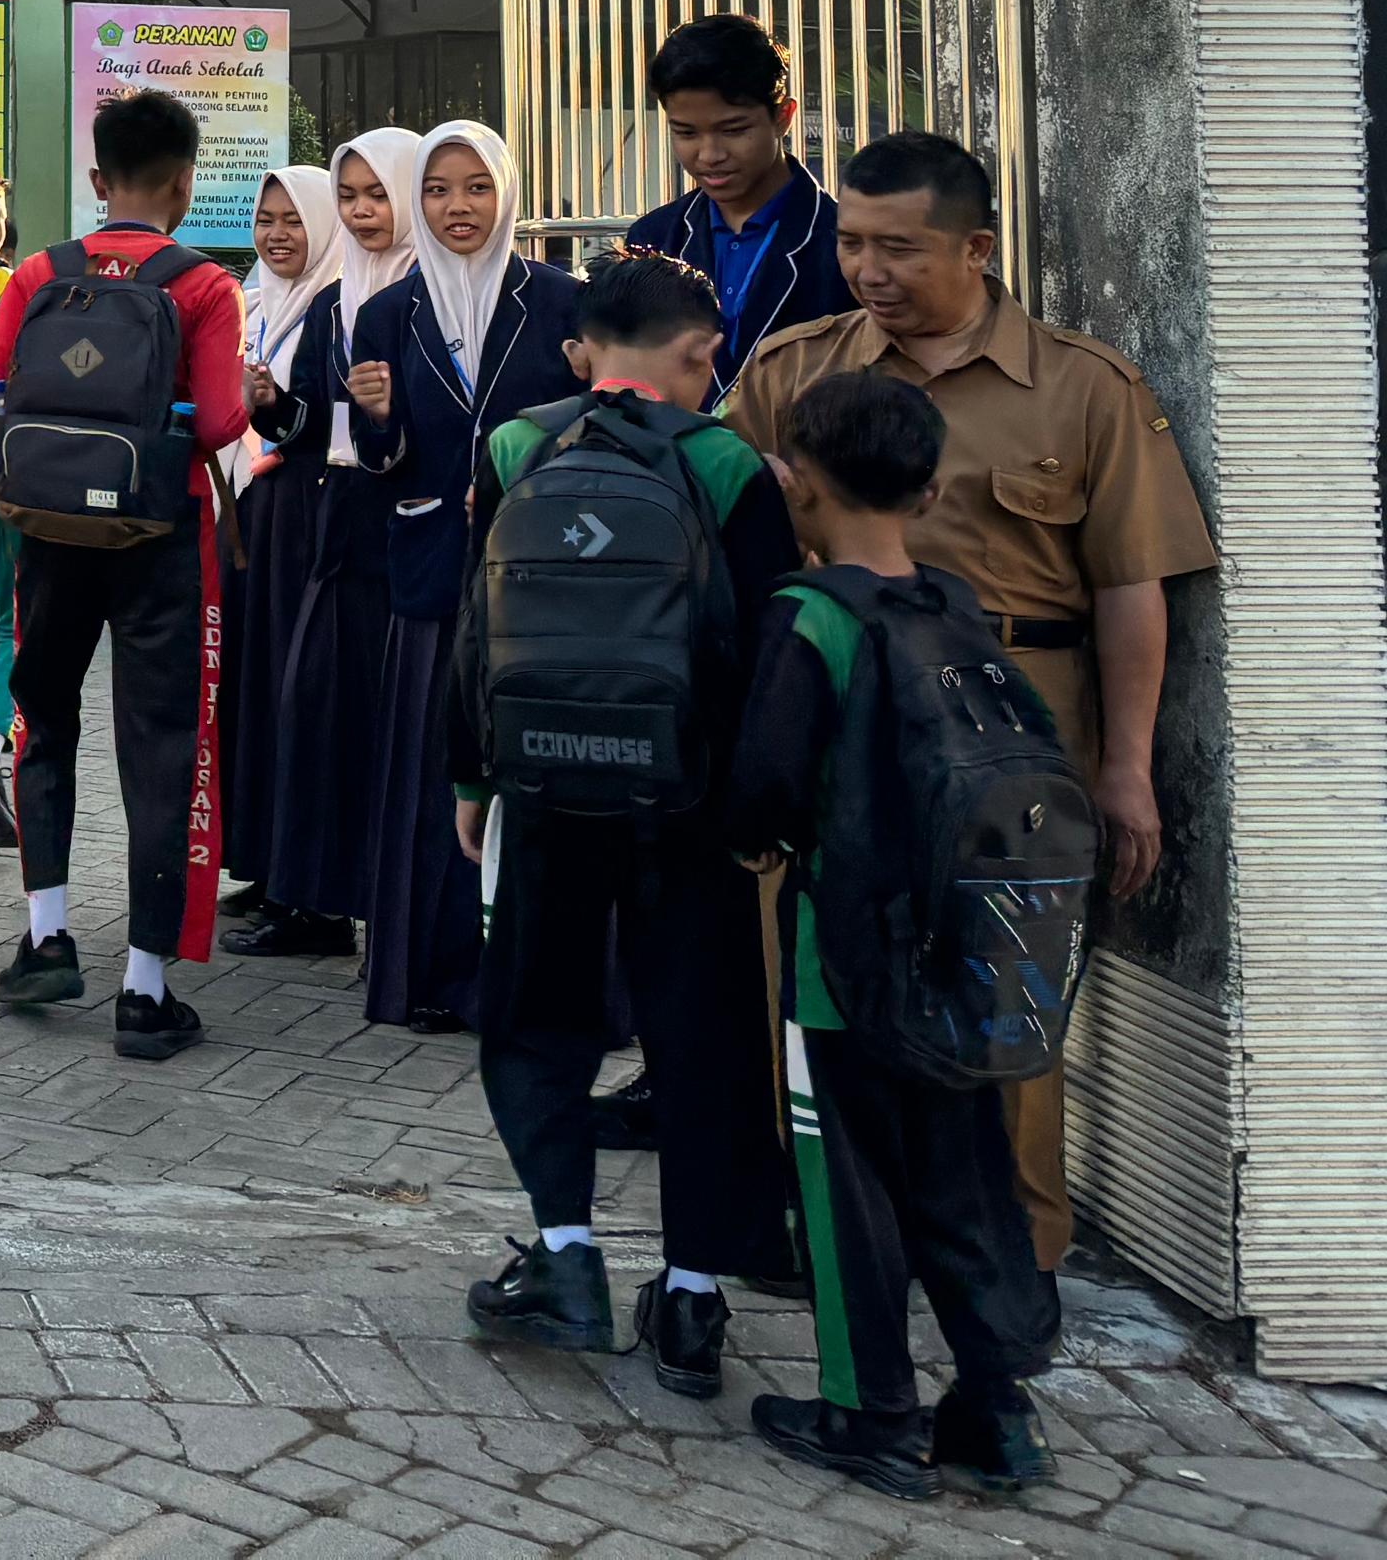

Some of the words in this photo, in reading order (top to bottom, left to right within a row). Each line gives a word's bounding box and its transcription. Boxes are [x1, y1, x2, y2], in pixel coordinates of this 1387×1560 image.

[134, 23, 237, 47] PERANAN
[96, 57, 142, 79] Bagi
[146, 58, 192, 76] Anak
[197, 60, 265, 78] Sekolah
[170, 89, 219, 99] SARAPAN
[226, 104, 262, 112] SELAMA
[194, 195, 239, 204] MEMBUAT
[522, 728, 653, 766] CONVERSE
